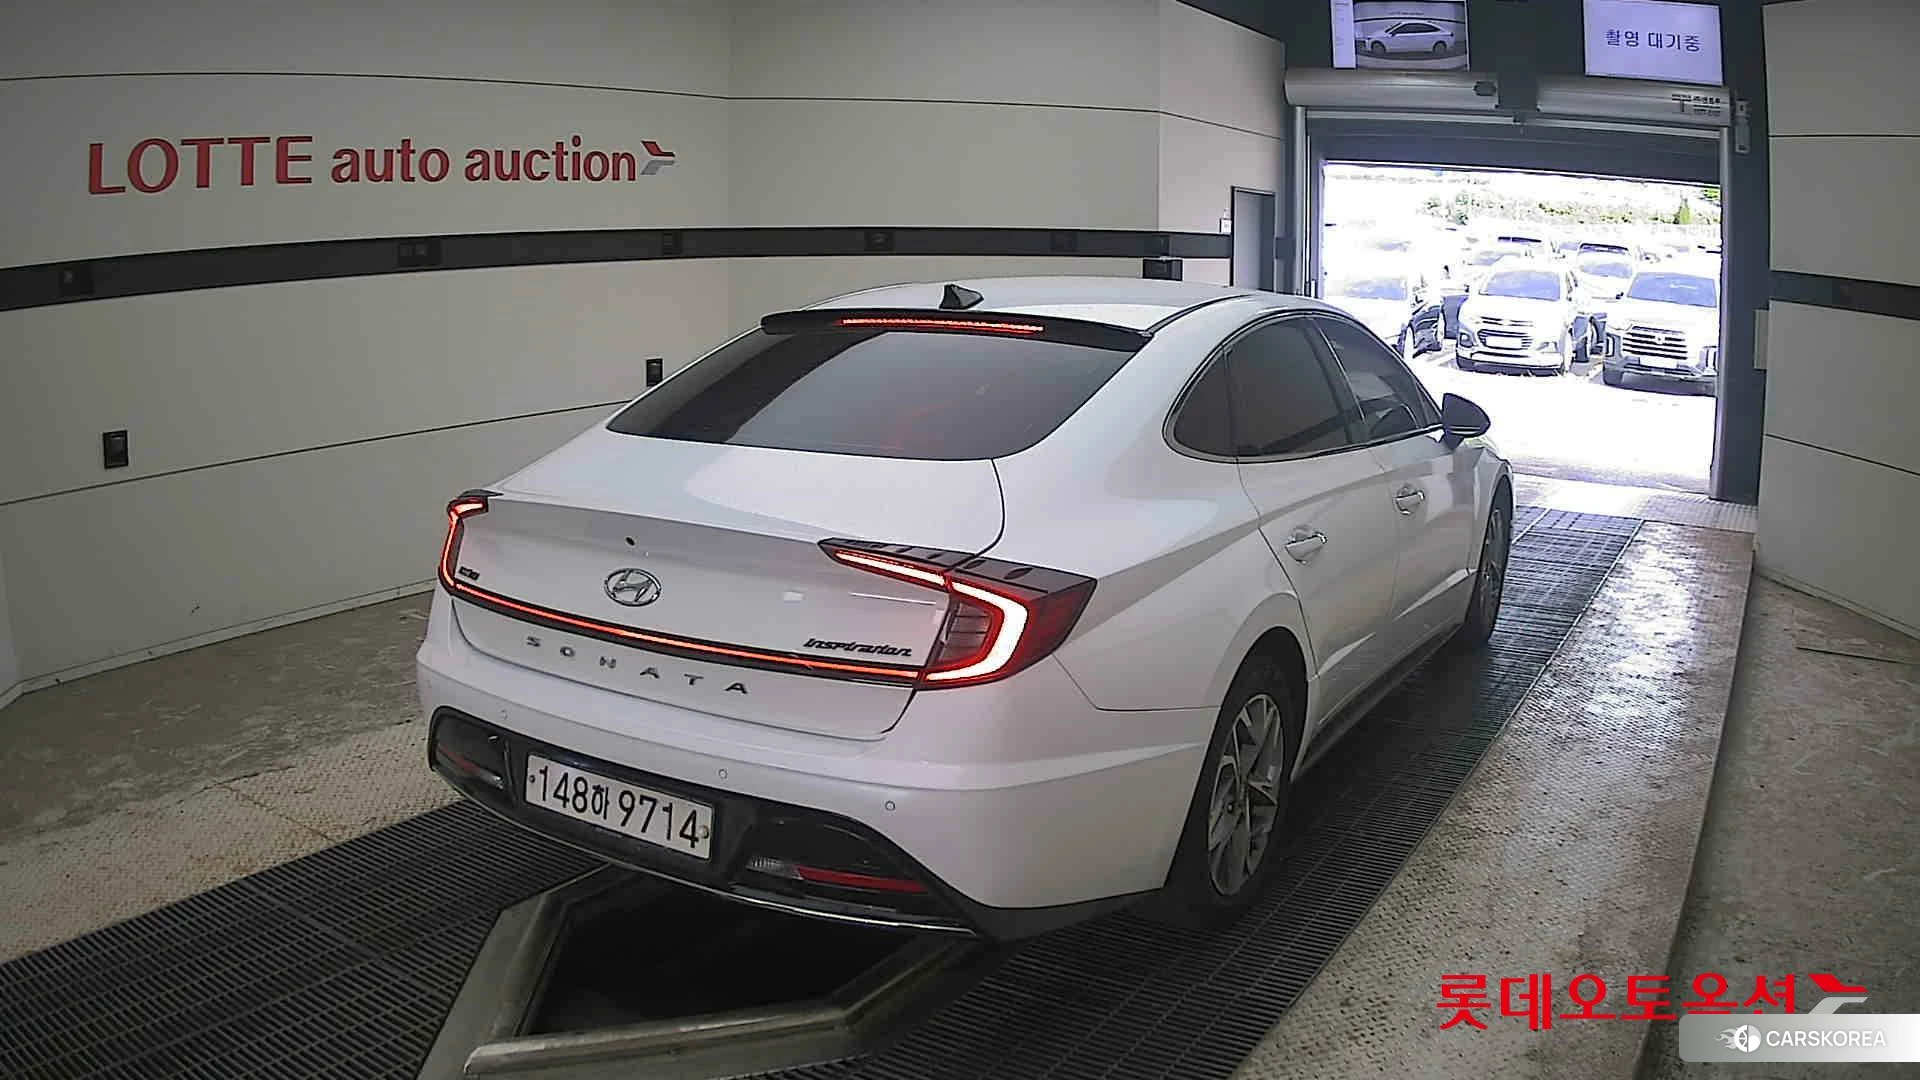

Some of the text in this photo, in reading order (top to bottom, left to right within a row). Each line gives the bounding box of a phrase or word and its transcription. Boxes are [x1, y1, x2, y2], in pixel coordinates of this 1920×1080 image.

[1647, 32, 1700, 52] 대기중
[89, 135, 637, 194] LOTTE auto auction
[526, 635, 749, 695] SONATA
